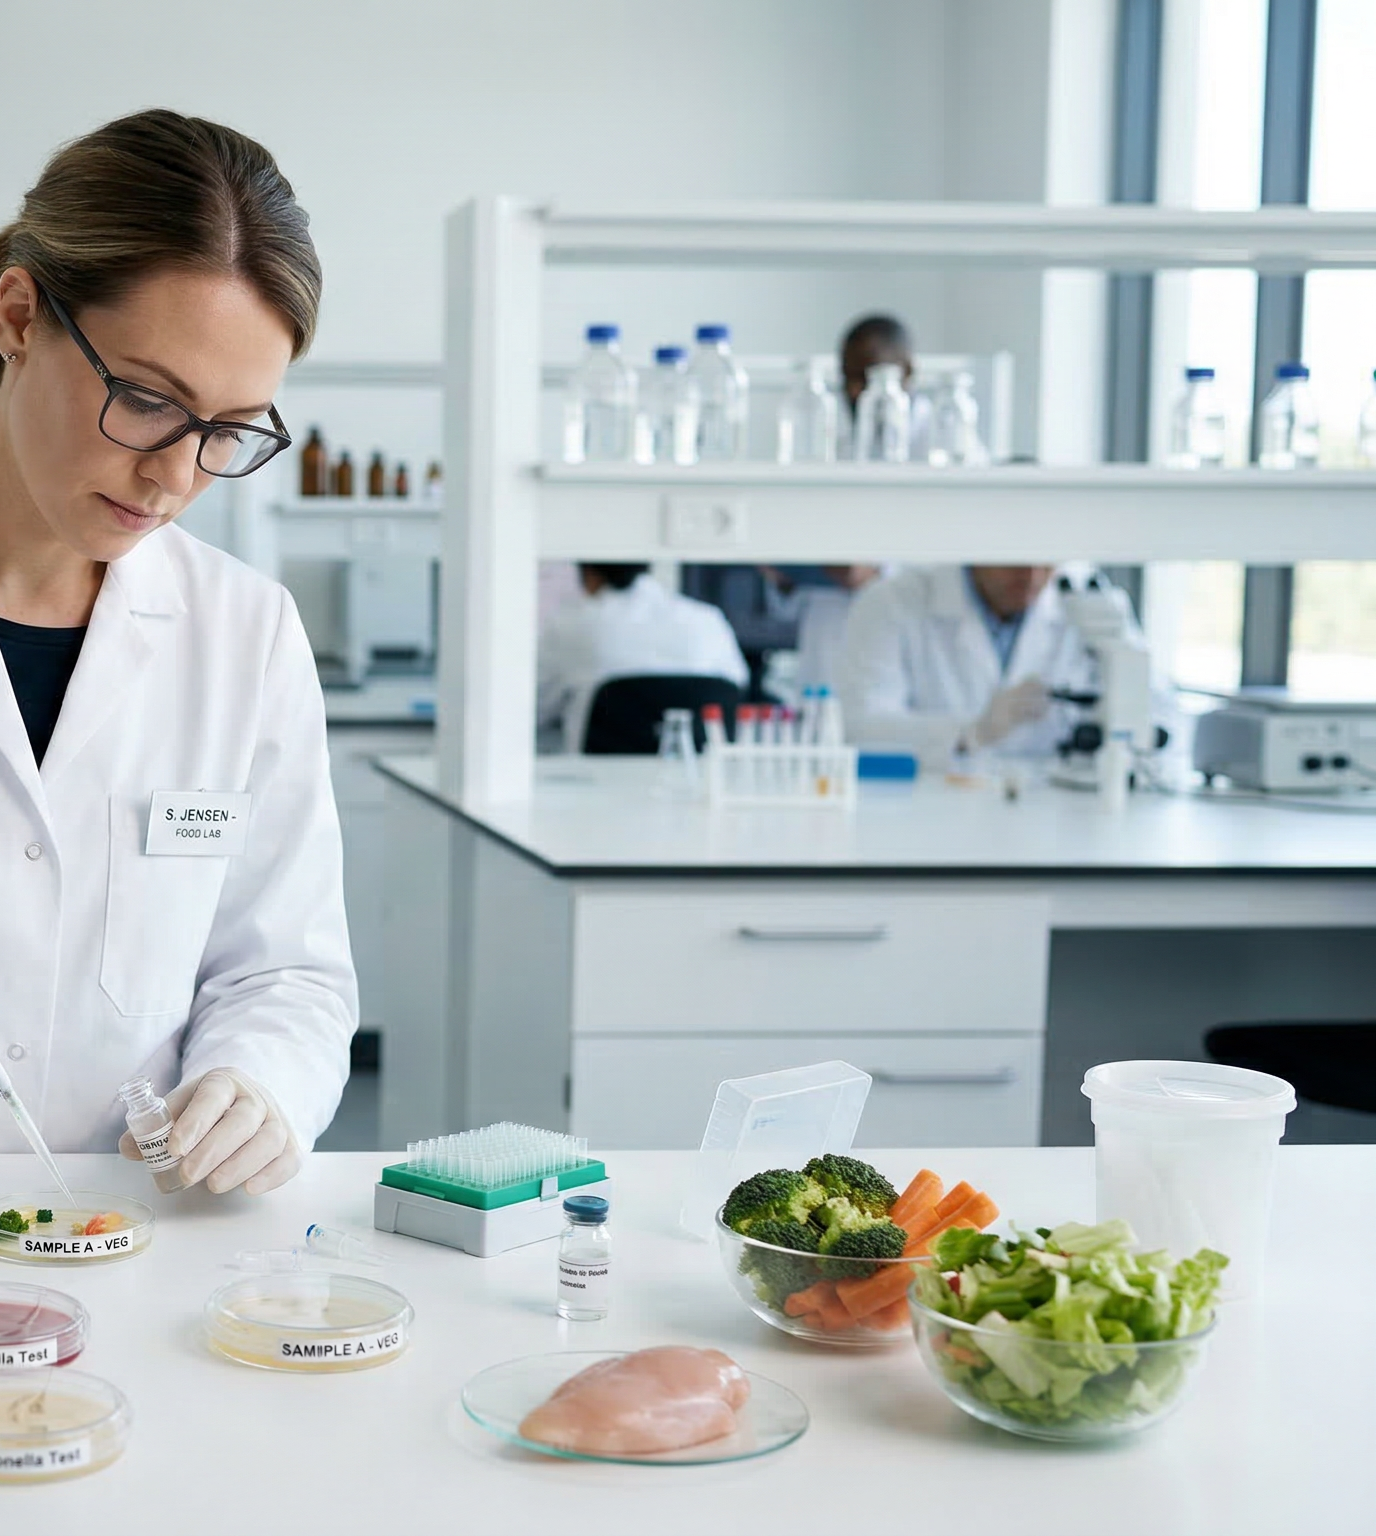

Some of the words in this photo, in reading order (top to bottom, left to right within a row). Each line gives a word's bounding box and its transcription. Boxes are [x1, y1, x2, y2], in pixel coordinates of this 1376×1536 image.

[165, 808, 176, 820] S.
[180, 809, 228, 821] JENSEN
[175, 828, 201, 838] FOOD
[24, 1240, 80, 1253] SAMPLE
[84, 1241, 93, 1252] A
[104, 1236, 128, 1250] VEG
[356, 1341, 365, 1354] A
[376, 1331, 398, 1349] VEG
[18, 1347, 47, 1363] Test
[48, 1447, 80, 1464] Test
